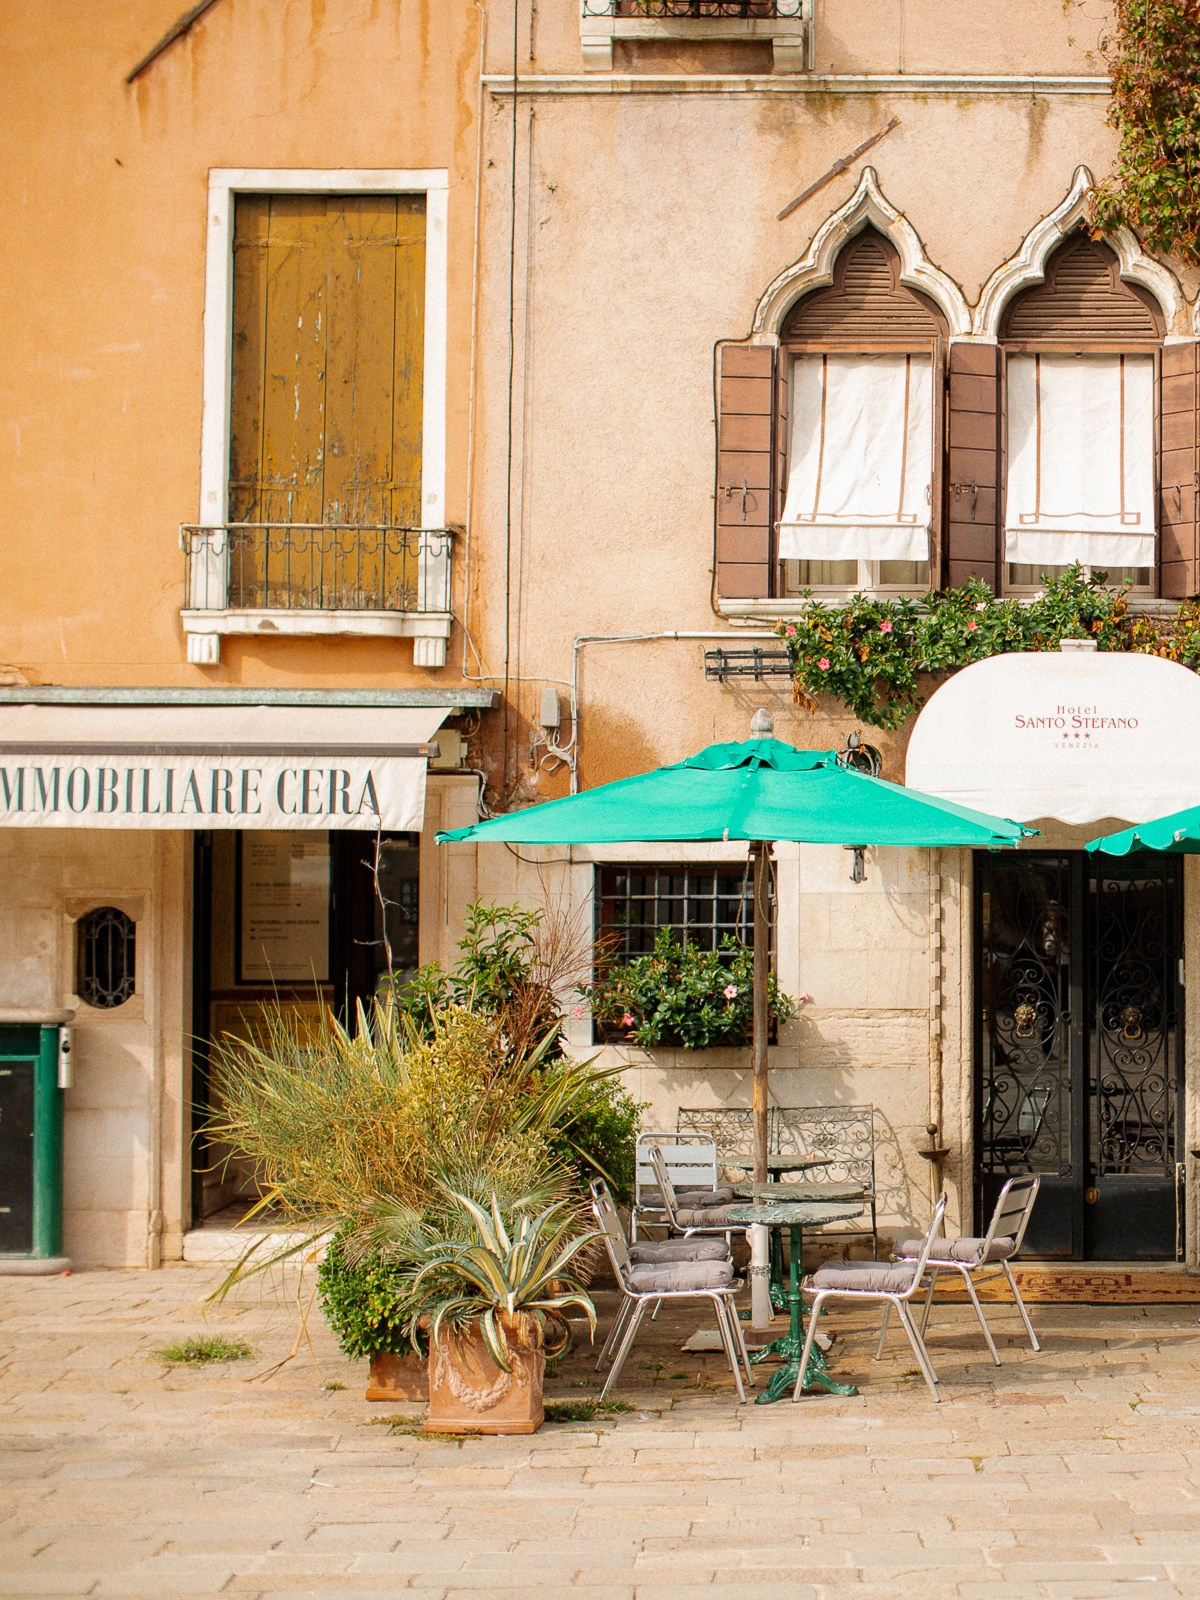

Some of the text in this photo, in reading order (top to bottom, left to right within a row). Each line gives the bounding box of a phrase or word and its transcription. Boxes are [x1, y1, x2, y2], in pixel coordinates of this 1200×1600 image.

[1057, 705, 1097, 714] Hotel
[1015, 715, 1139, 729] SANTO STEFANO
[275, 768, 383, 815] CERA
